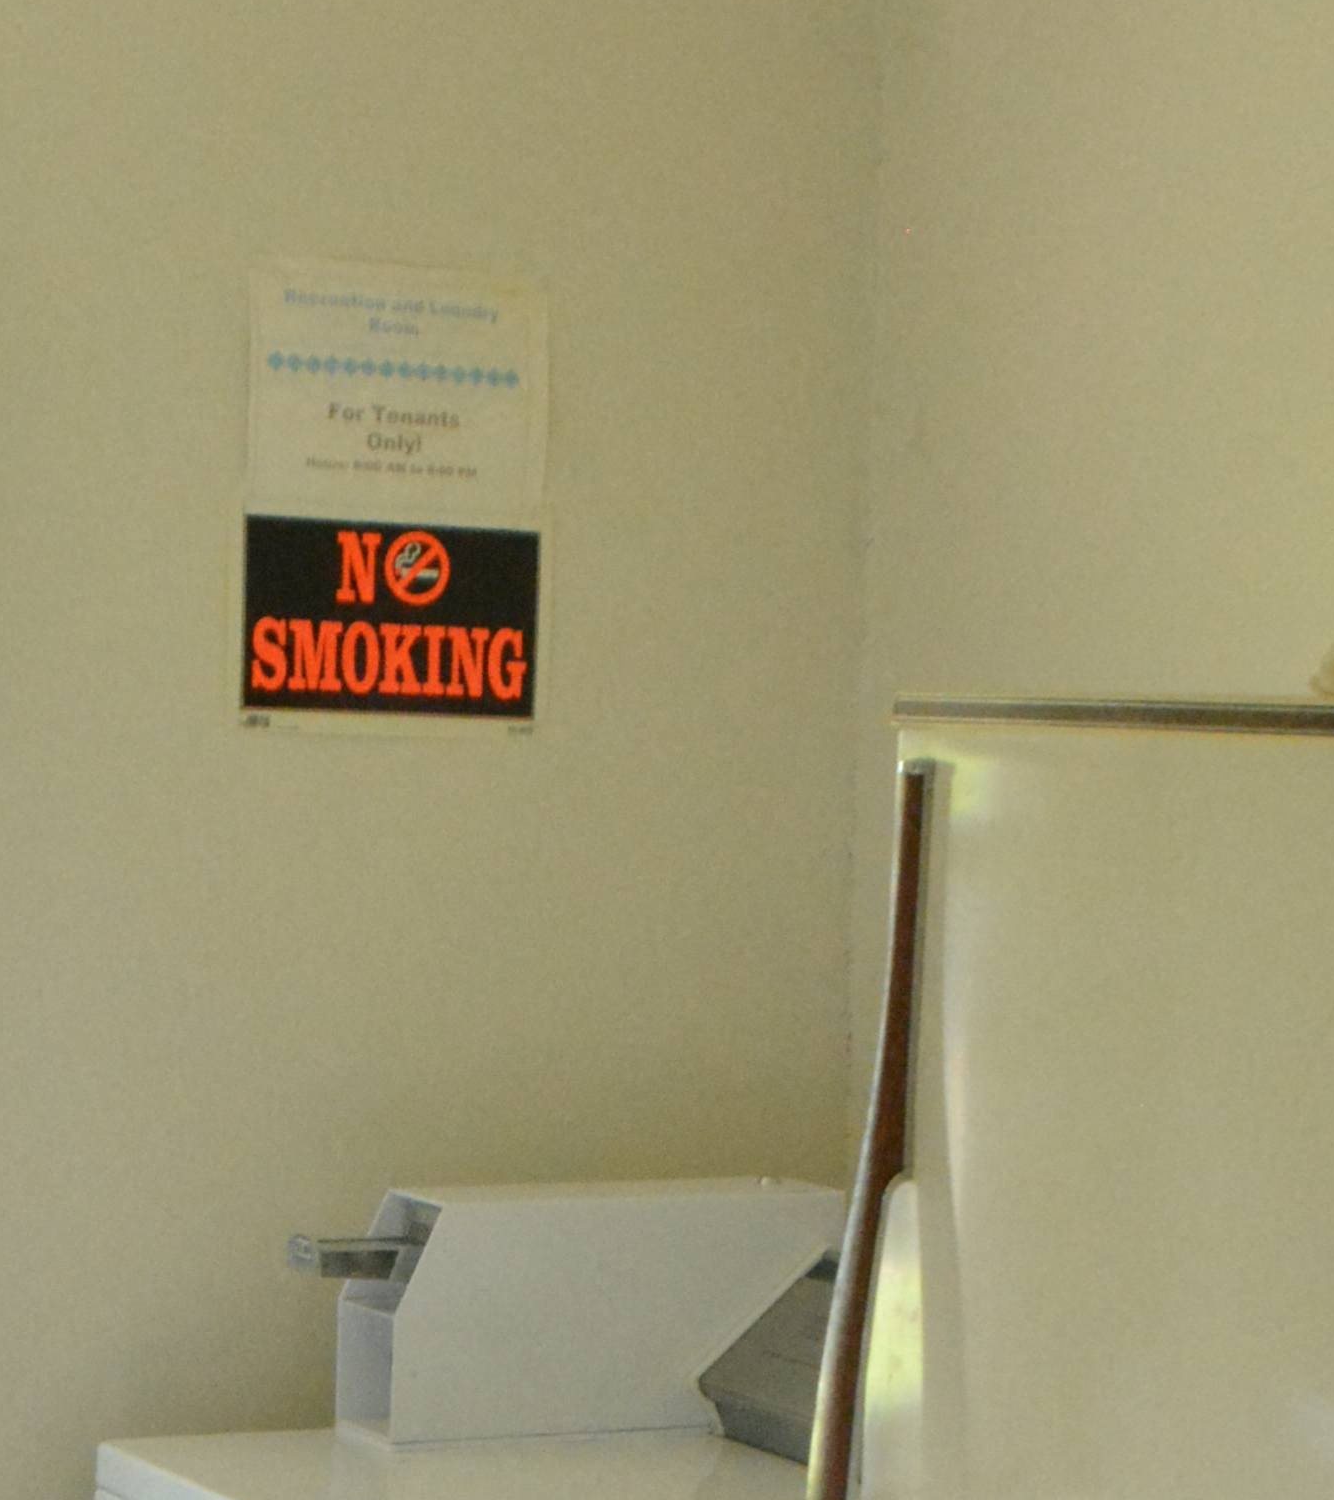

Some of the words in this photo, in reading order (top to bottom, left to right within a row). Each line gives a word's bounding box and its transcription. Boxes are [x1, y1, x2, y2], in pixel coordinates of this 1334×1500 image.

[328, 402, 364, 422] For
[371, 404, 460, 427] Tenants
[367, 431, 421, 455] Only!
[251, 615, 527, 700] SMOKING
